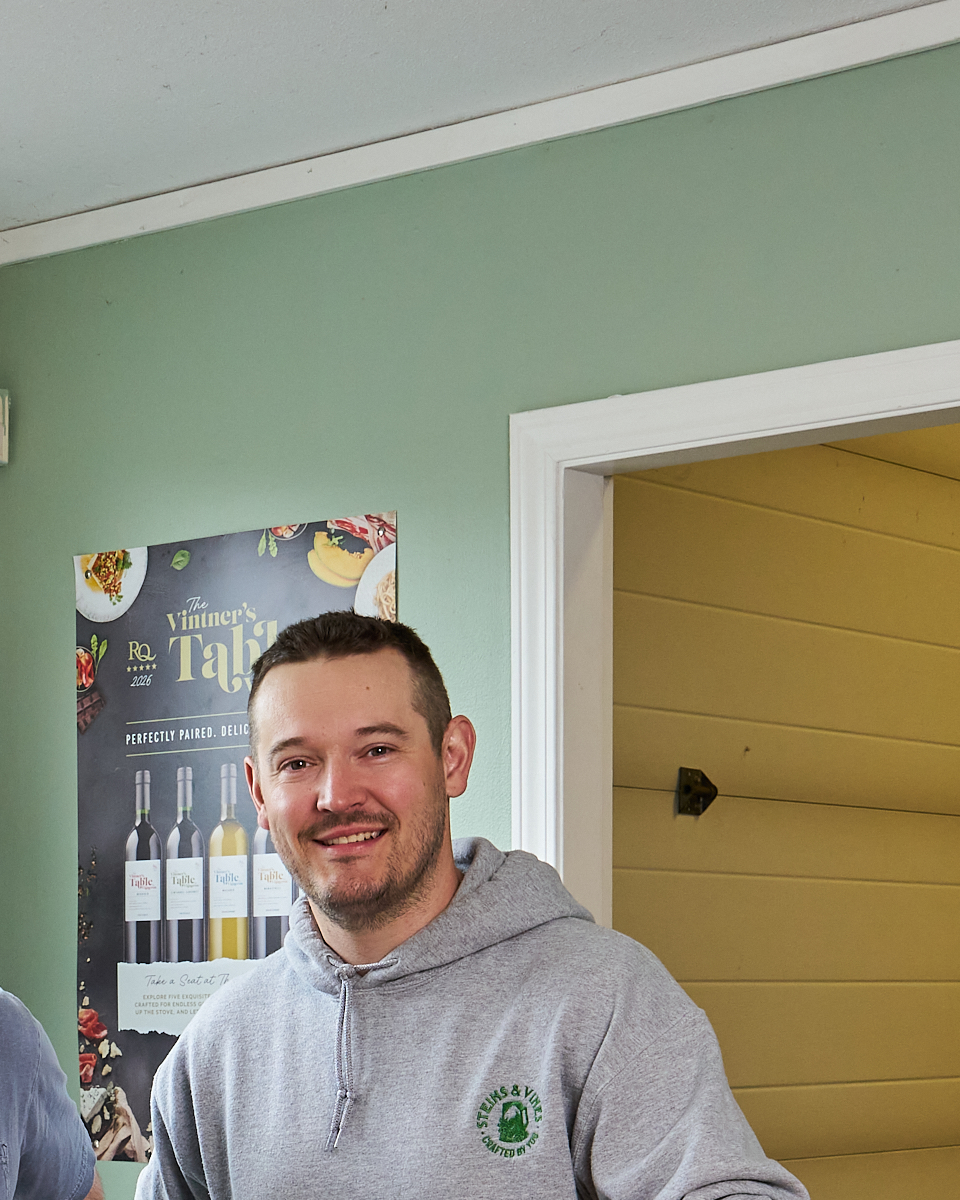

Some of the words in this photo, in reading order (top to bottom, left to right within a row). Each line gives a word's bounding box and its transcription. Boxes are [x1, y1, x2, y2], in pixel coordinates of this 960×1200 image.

[186, 596, 208, 613] The
[166, 602, 257, 632] Vintner's
[128, 640, 157, 662] RQ
[168, 620, 278, 693] Tabl
[130, 674, 153, 687] 2026
[126, 730, 175, 745] PERFECTLY
[179, 727, 217, 741] PAIRED.
[221, 724, 249, 737] DELIC
[145, 975, 167, 987] Take
[180, 974, 204, 986] Seat
[203, 976, 216, 985] at
[218, 973, 230, 985] Th
[477, 1086, 508, 1128] STEINS
[511, 1084, 521, 1096] &
[525, 1086, 542, 1122] VINES
[482, 1136, 515, 1158] CRAFTED
